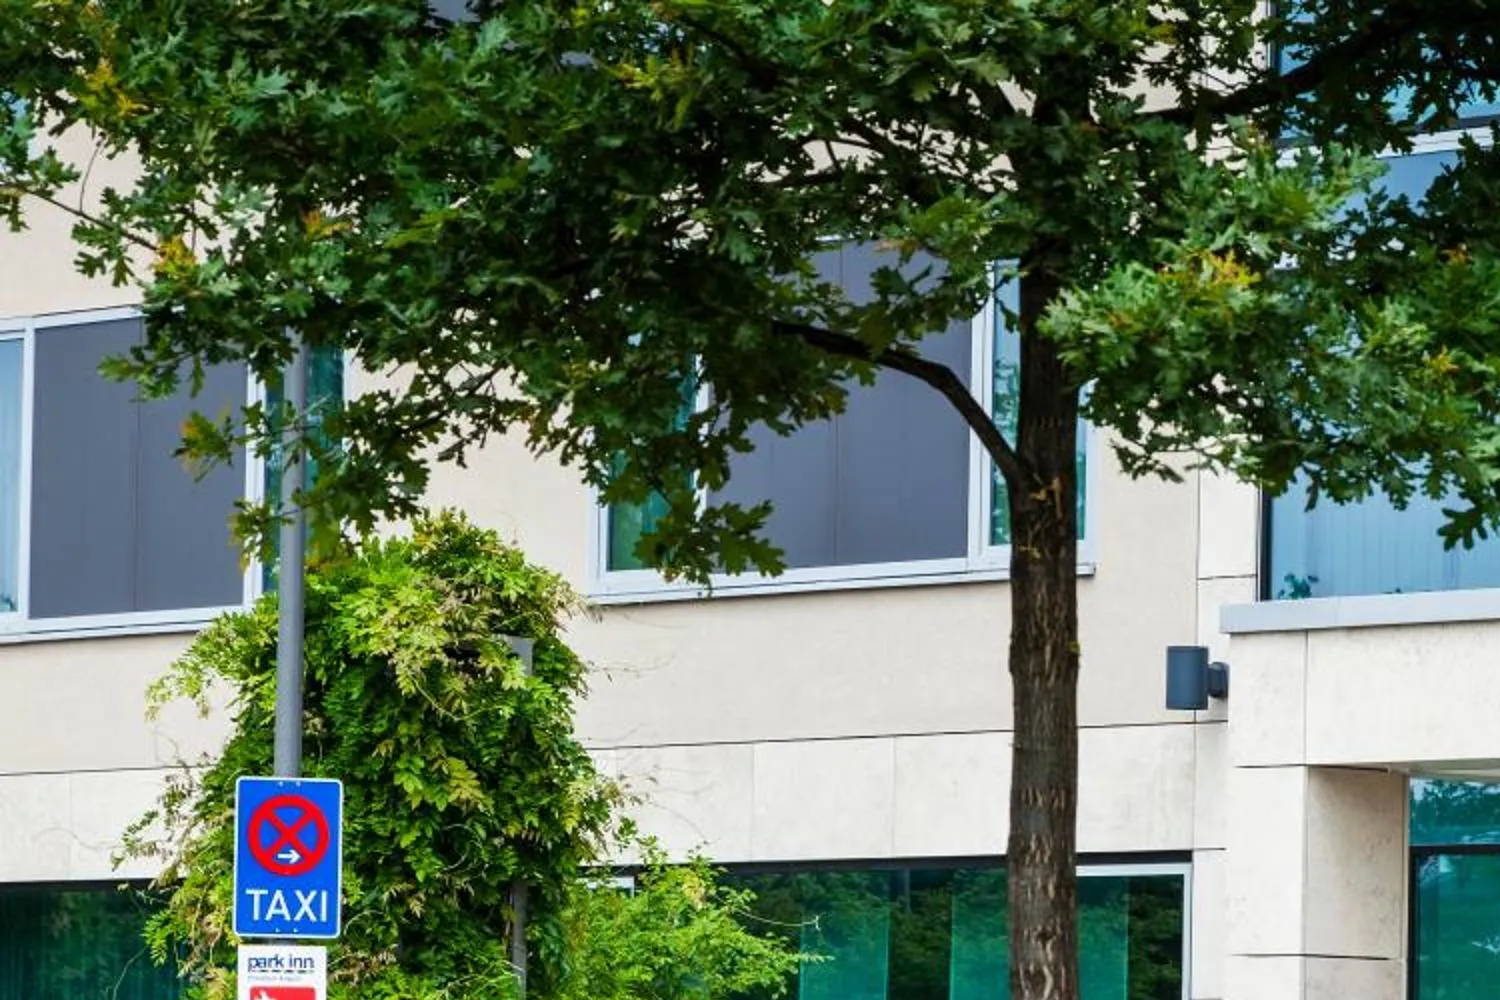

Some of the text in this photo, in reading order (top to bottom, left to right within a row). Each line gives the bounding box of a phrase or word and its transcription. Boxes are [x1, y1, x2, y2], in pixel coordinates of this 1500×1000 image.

[245, 889, 328, 923] TAXI
[247, 953, 315, 973] park inn
